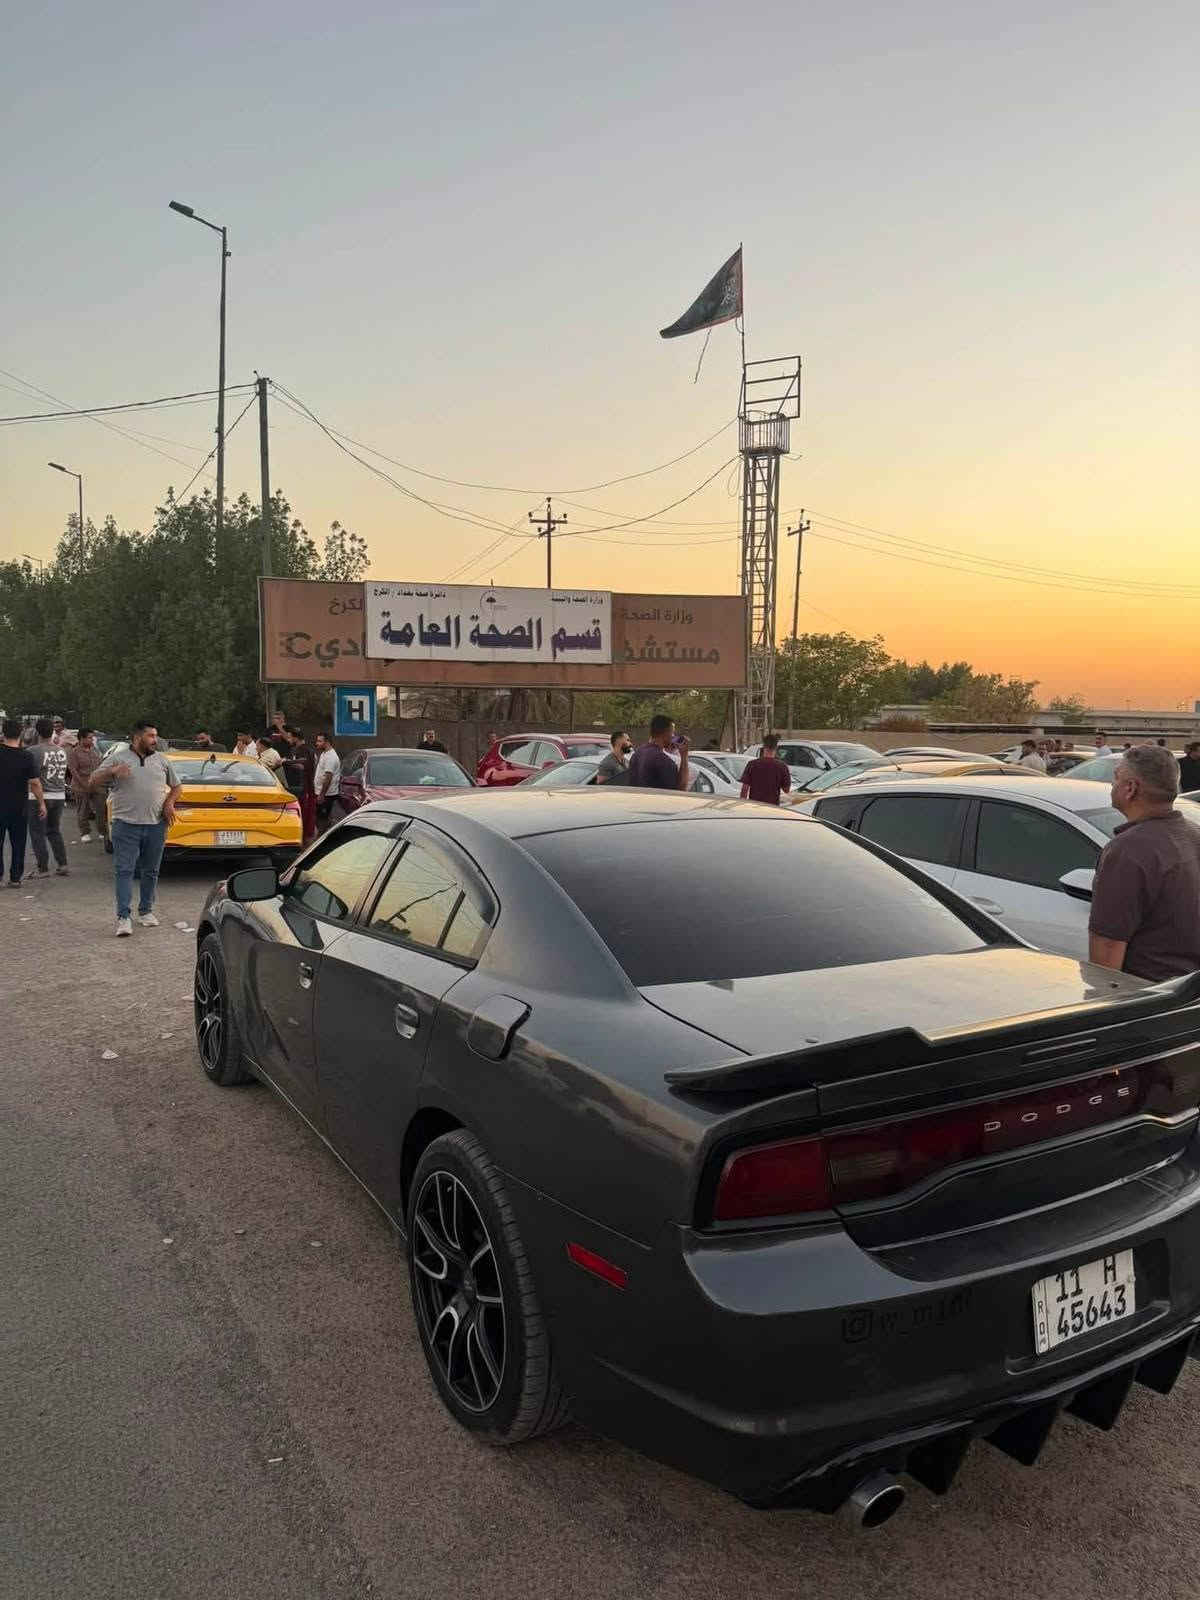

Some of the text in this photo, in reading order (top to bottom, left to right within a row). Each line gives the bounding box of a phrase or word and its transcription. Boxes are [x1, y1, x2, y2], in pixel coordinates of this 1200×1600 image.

[623, 607, 696, 624] وزارة الصحة
[381, 610, 602, 661] قسم الصحة العامة
[346, 698, 366, 722] H
[1103, 1254, 1117, 1285] H
[1057, 1284, 1127, 1337] 45643
